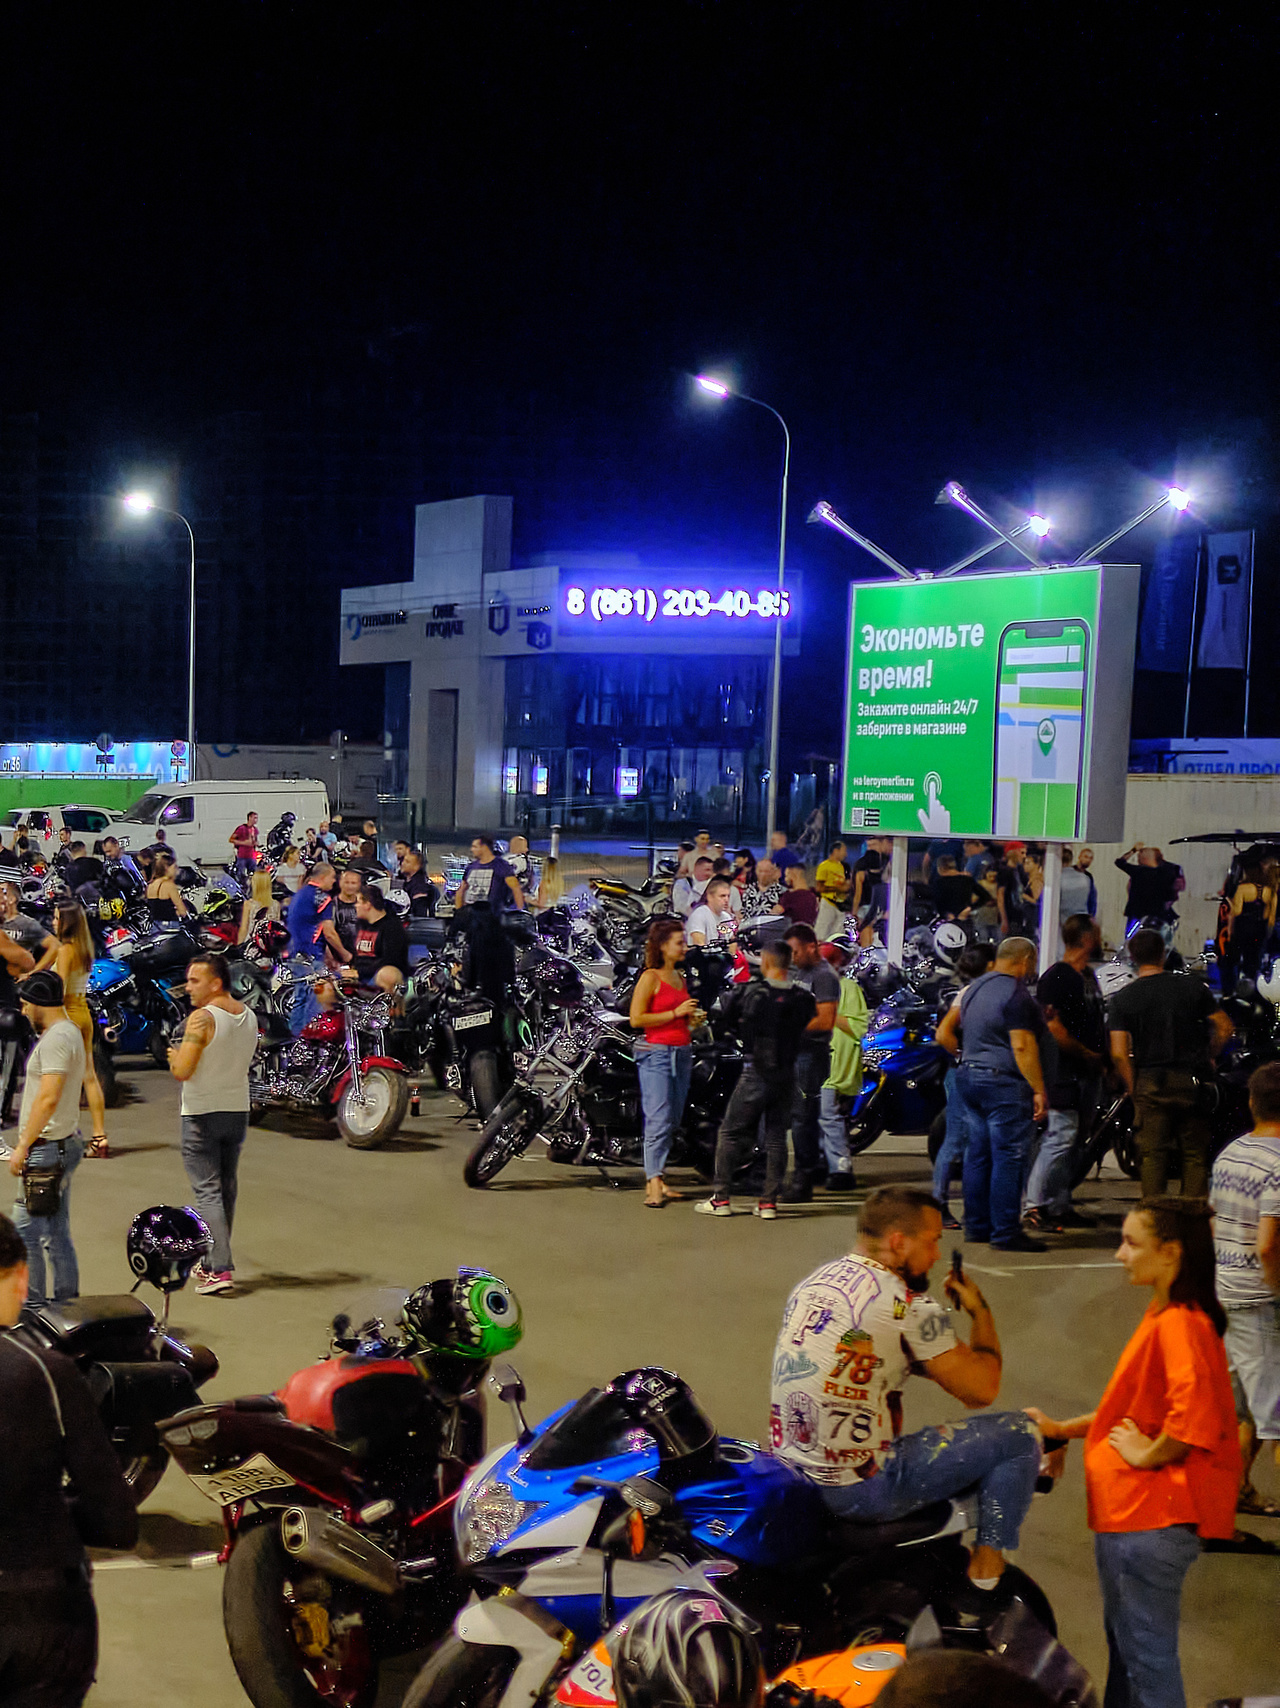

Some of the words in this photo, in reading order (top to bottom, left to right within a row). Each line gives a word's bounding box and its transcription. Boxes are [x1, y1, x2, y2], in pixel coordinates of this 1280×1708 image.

[566, 588, 585, 615] 8
[591, 588, 657, 621] (861)
[662, 588, 790, 617] 203-40-85
[860, 623, 985, 653] Экономьте
[858, 659, 933, 697] время!
[857, 702, 909, 717] Закажите
[910, 699, 951, 715] онлайн
[953, 698, 979, 716] 24/7
[856, 720, 904, 739] заберите
[905, 722, 911, 735] в
[913, 722, 967, 735] магазине
[853, 777, 863, 786] на
[863, 775, 915, 788] leroymerlin.ru
[852, 792, 858, 801] и
[865, 792, 914, 803] приложении
[828, 1410, 872, 1444] 78
